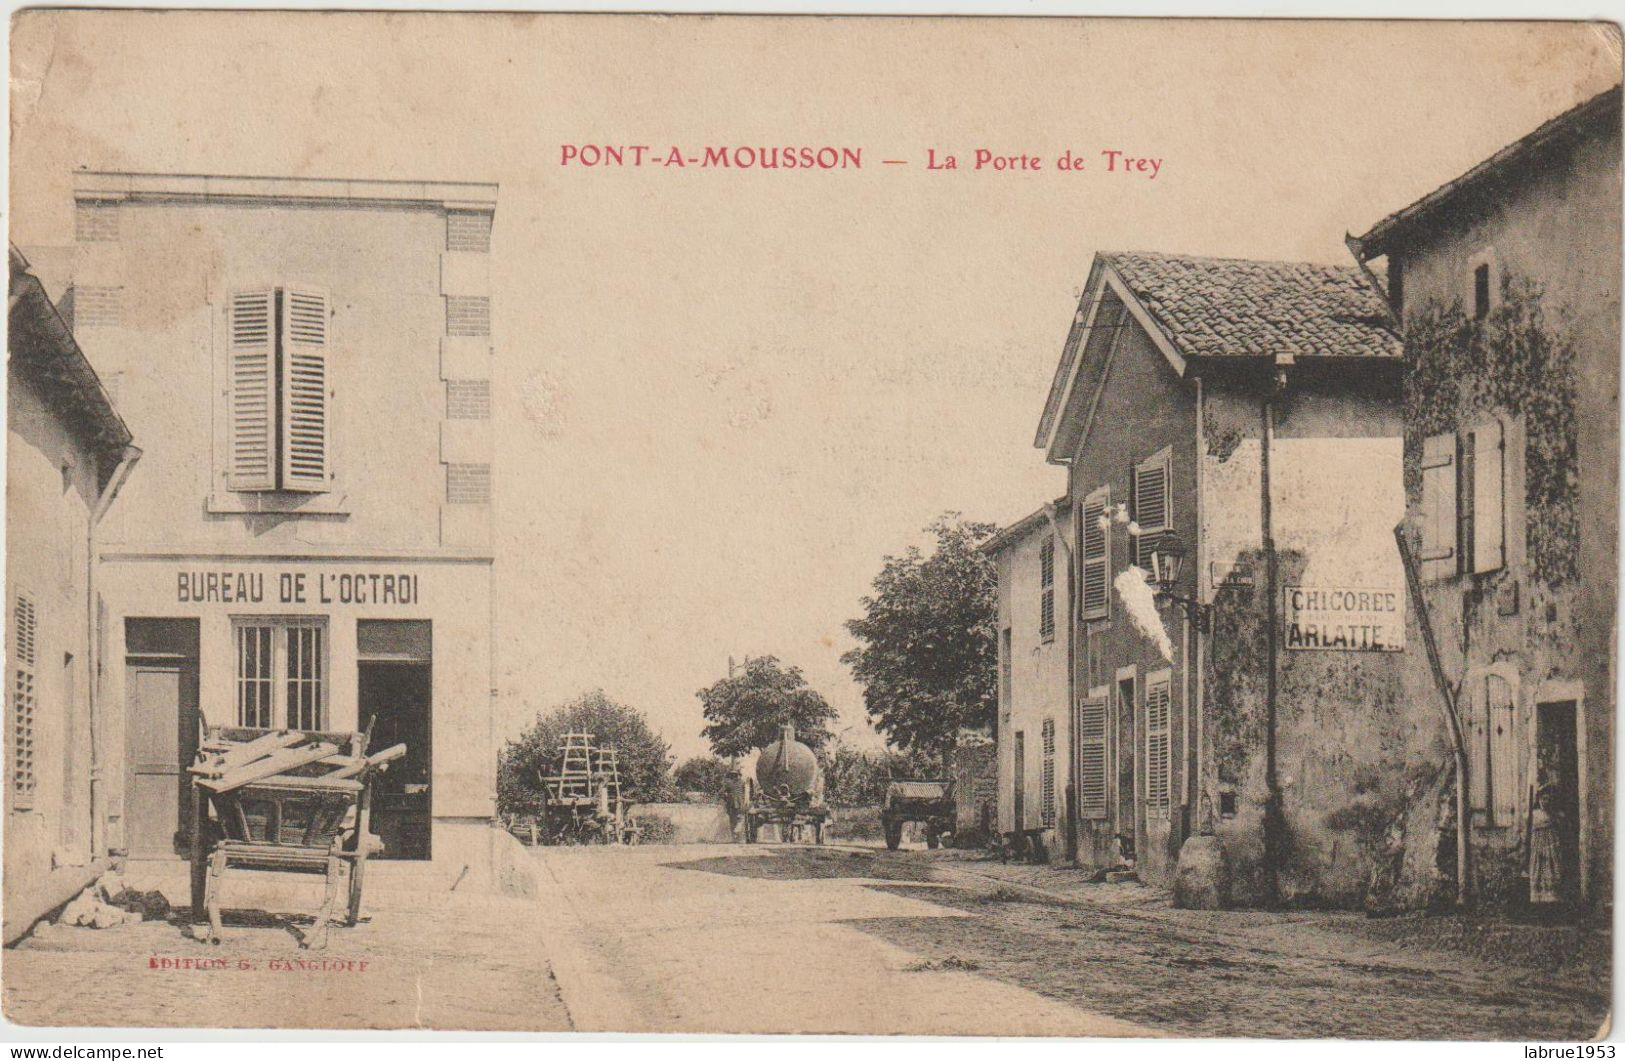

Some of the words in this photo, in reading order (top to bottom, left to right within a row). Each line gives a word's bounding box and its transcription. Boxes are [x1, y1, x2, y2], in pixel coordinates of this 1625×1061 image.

[561, 145, 863, 168] PONT-A-MOUSSON
[927, 149, 957, 170] La
[975, 149, 1042, 170] Porte
[1057, 150, 1086, 171] de
[1102, 151, 1164, 179] Trey
[178, 573, 263, 602] BUREAU
[280, 573, 306, 602] DE
[321, 574, 418, 604] L'OCTROI
[1288, 623, 1384, 648] ARLATTE
[238, 959, 258, 971] G.
[269, 959, 370, 972] GANGLOFF
